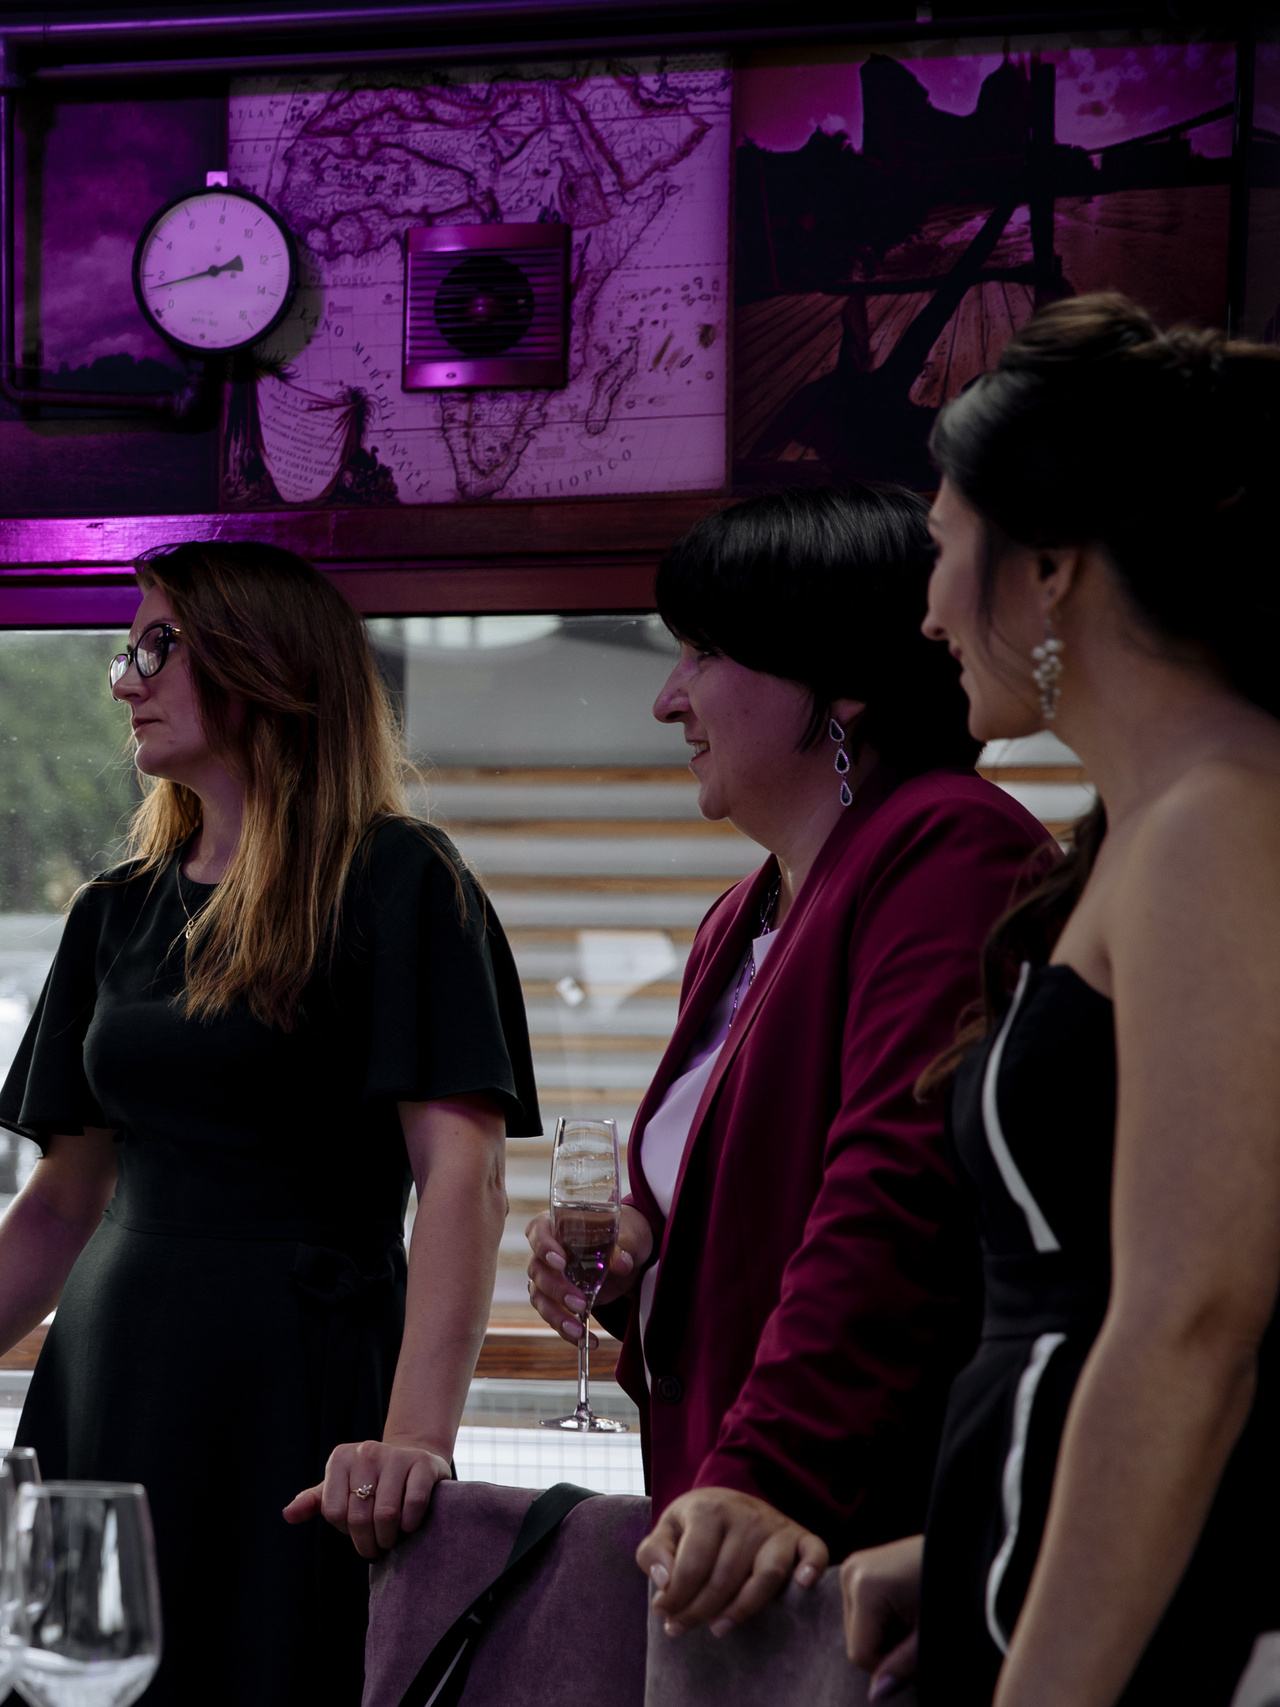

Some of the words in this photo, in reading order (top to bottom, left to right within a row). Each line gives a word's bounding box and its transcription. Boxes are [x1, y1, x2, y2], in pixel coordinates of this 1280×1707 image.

[189, 219, 196, 230] 6
[219, 214, 226, 225] 8
[244, 228, 254, 239] 10
[166, 241, 173, 251] 4
[259, 255, 269, 265] 12
[158, 270, 166, 280] 2
[257, 285, 266, 295] 14
[168, 298, 175, 309] 0
[239, 310, 248, 320] 16
